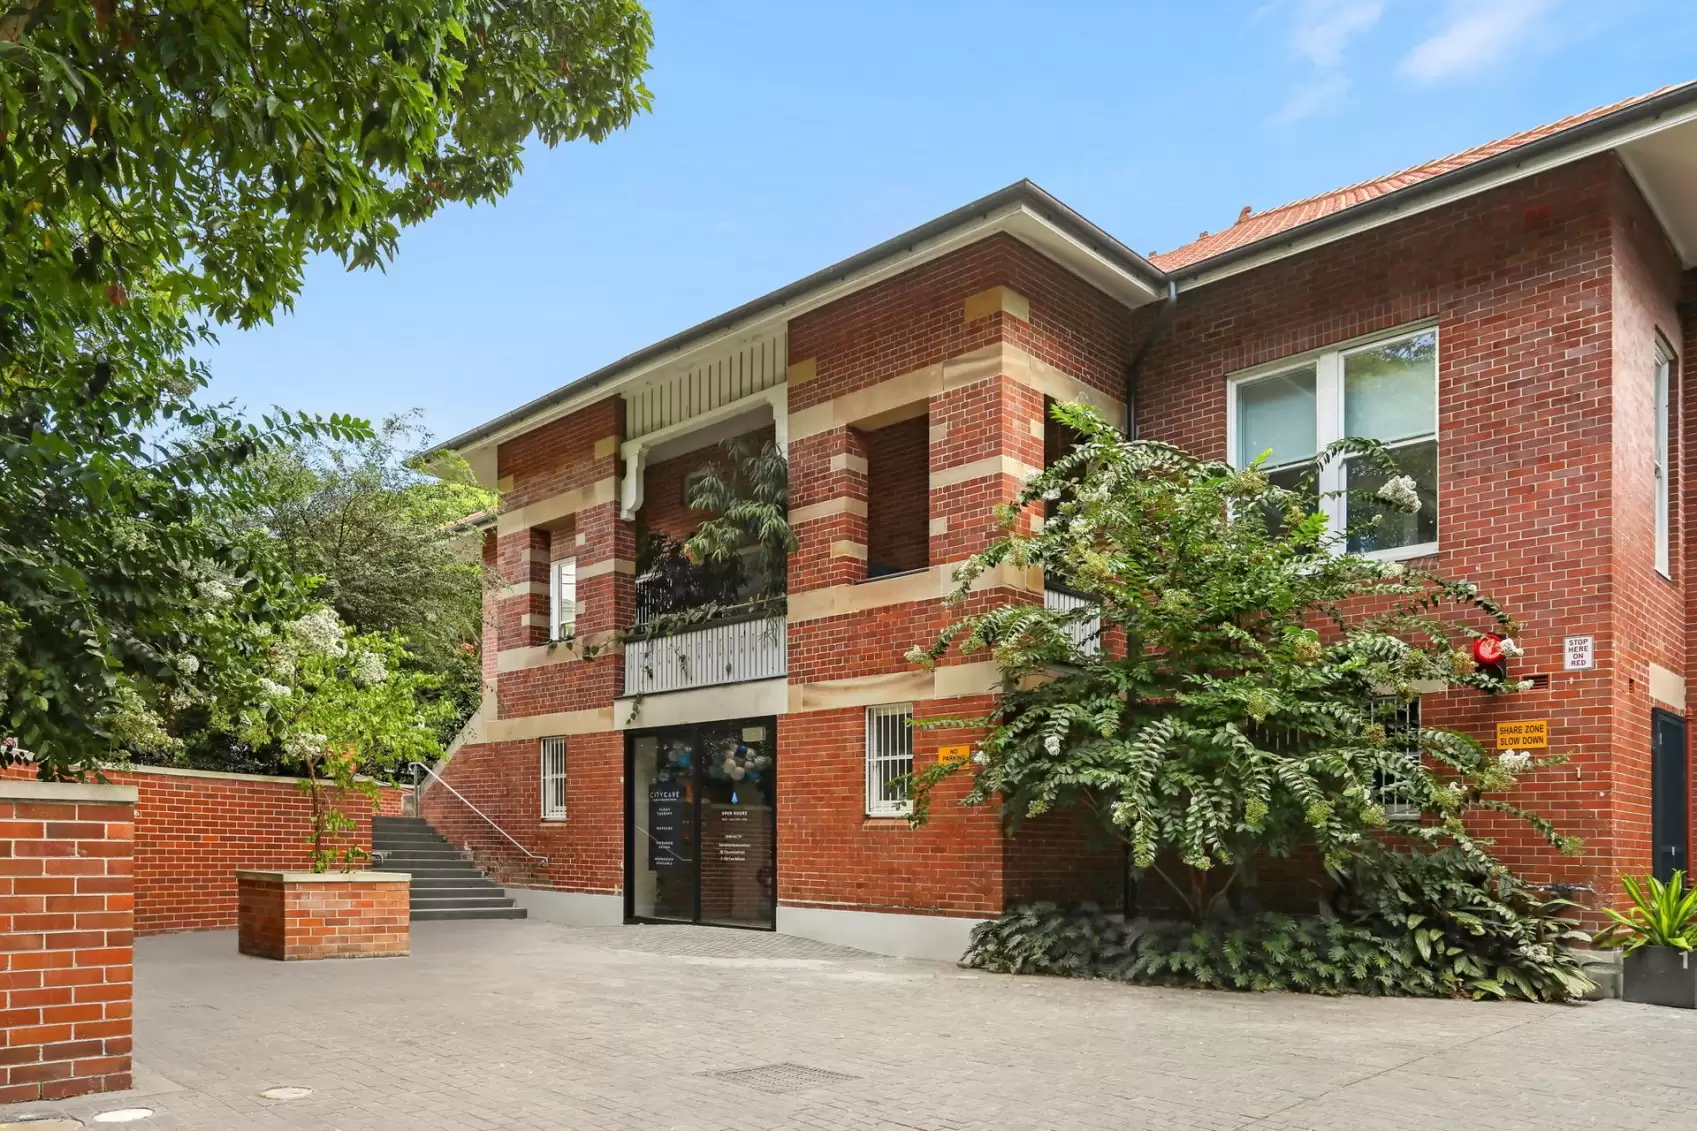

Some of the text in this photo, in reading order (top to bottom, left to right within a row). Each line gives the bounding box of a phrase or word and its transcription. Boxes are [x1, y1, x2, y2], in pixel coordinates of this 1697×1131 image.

[1500, 724, 1544, 734] SHARE ZONE
[1500, 736, 1544, 746] SLOW DOWN
